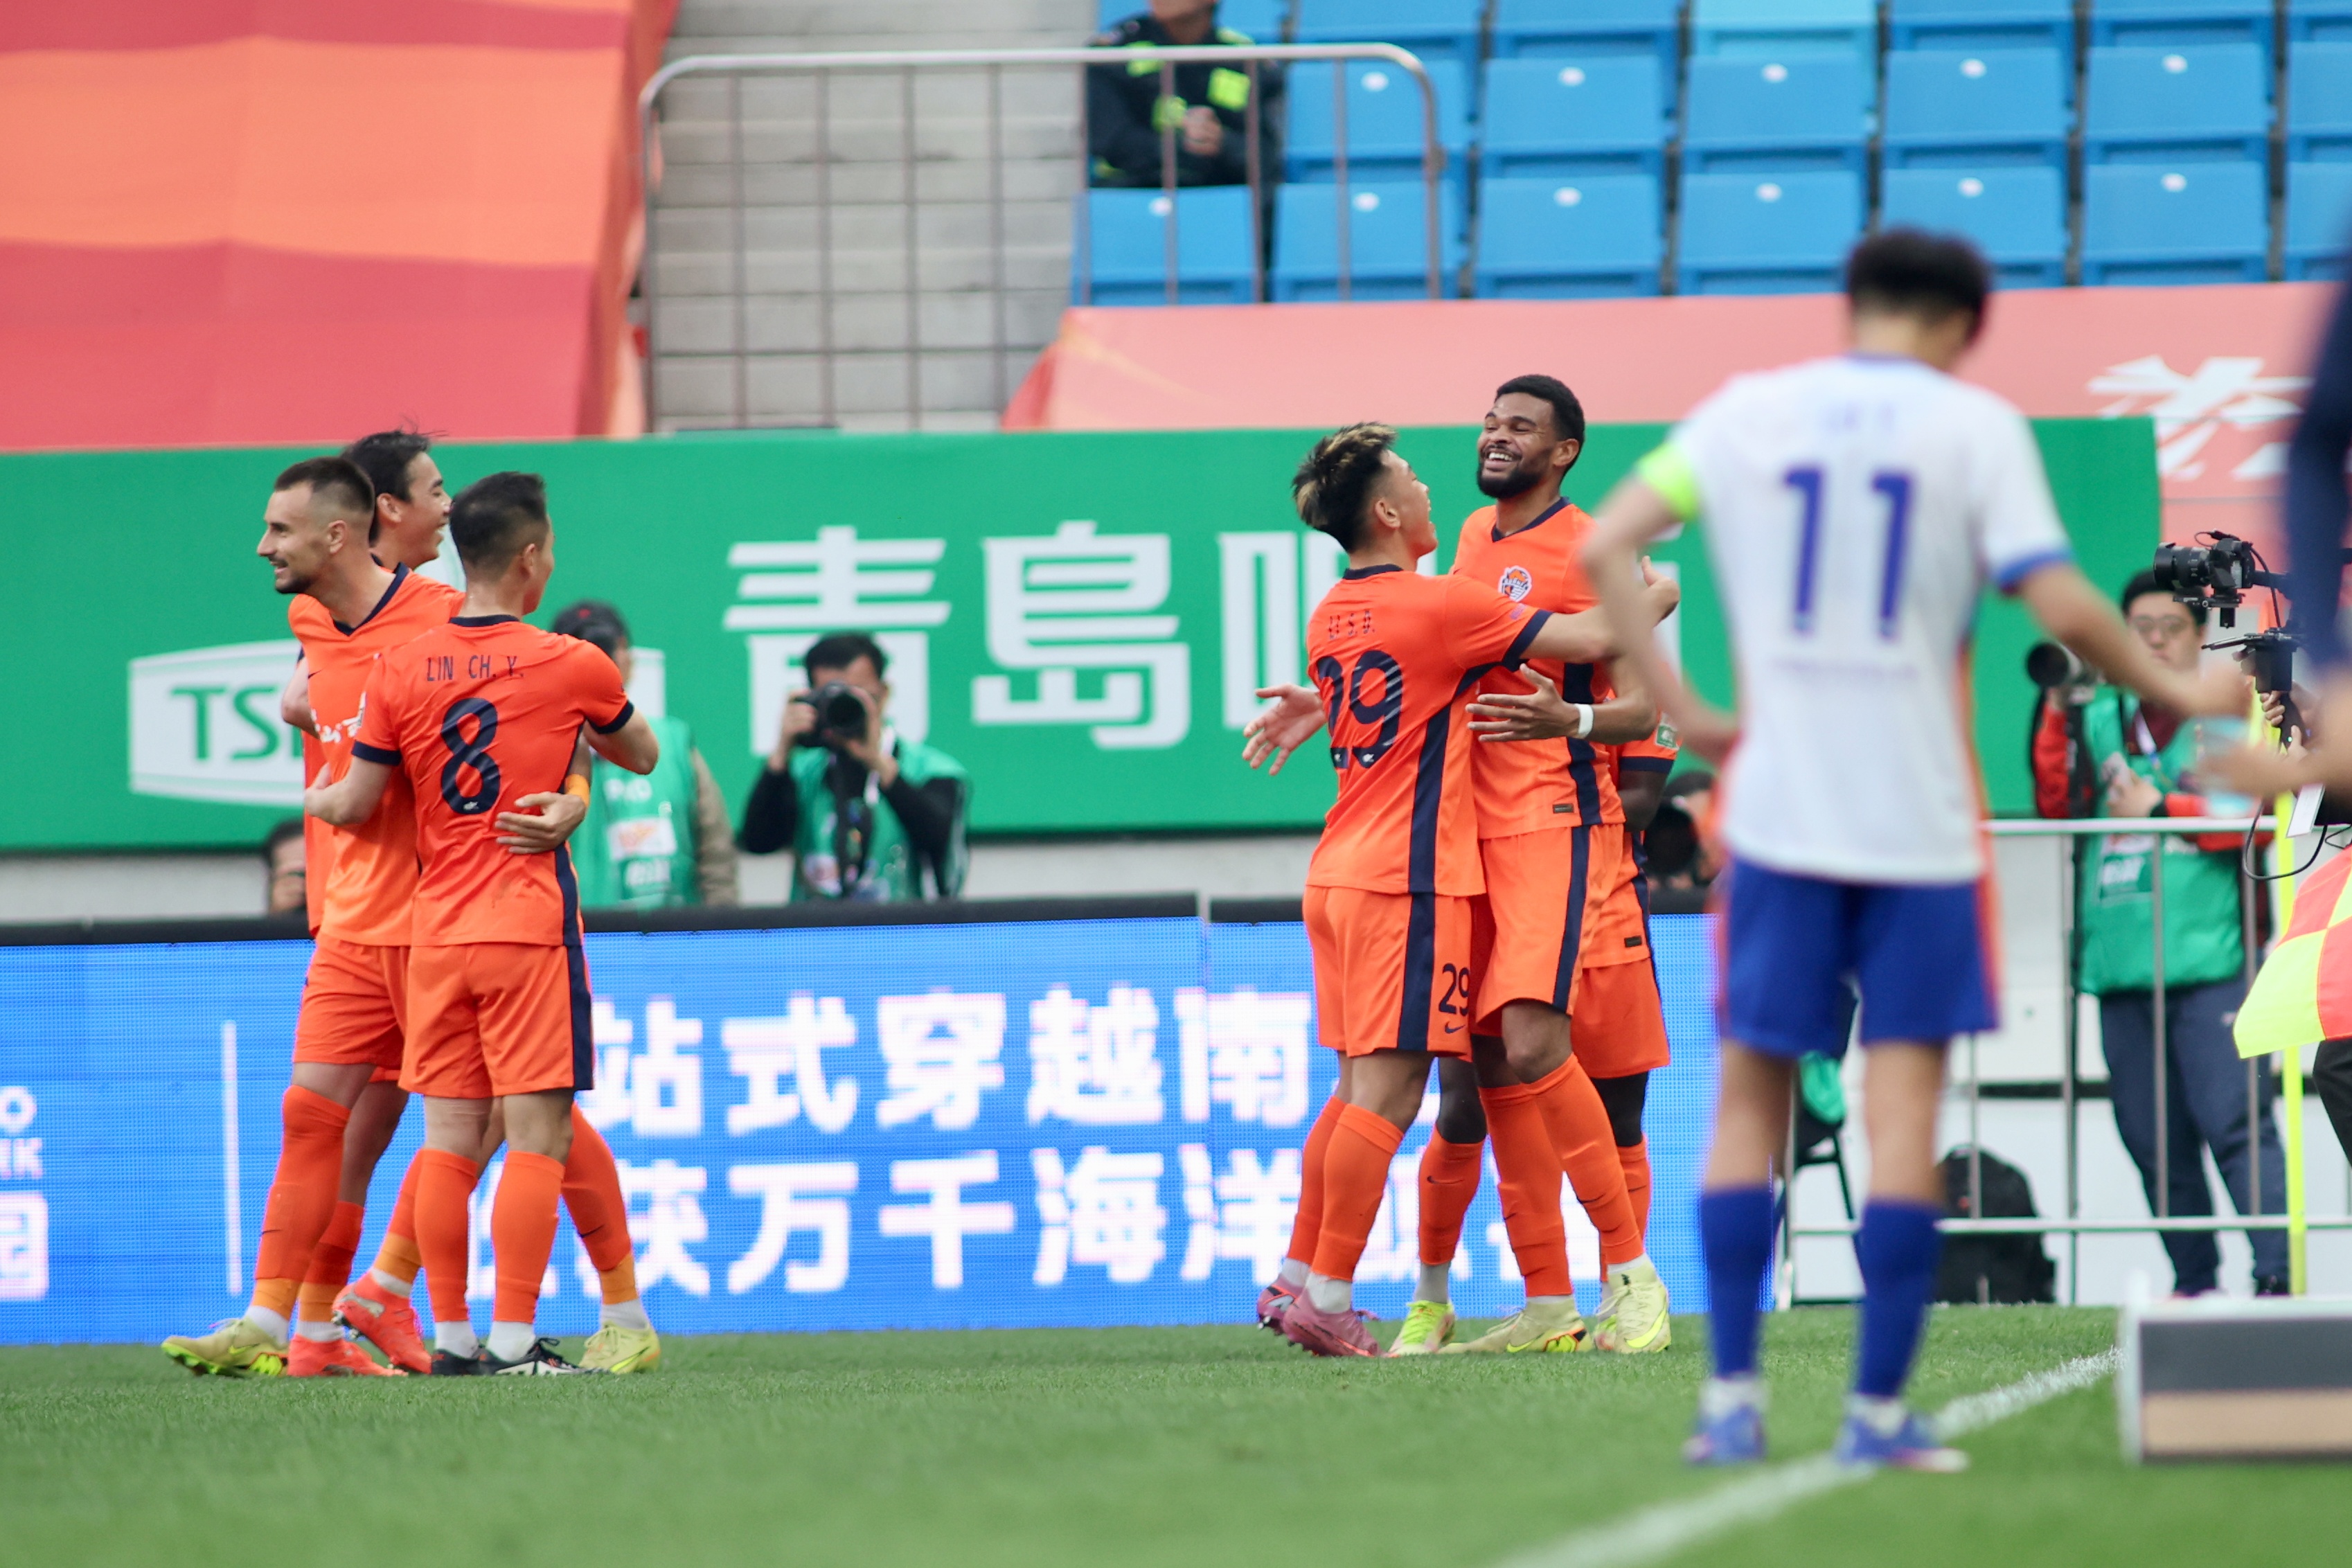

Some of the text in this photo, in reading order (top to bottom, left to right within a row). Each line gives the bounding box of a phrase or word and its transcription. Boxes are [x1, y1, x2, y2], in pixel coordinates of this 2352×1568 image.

[1783, 463, 1913, 637] 11
[427, 657, 454, 681] LIN
[468, 655, 497, 679] CH.
[1317, 650, 1403, 769] 29
[440, 697, 501, 815] 8
[1438, 963, 1470, 1017] 29
[575, 982, 1439, 1136] 站式穿越南
